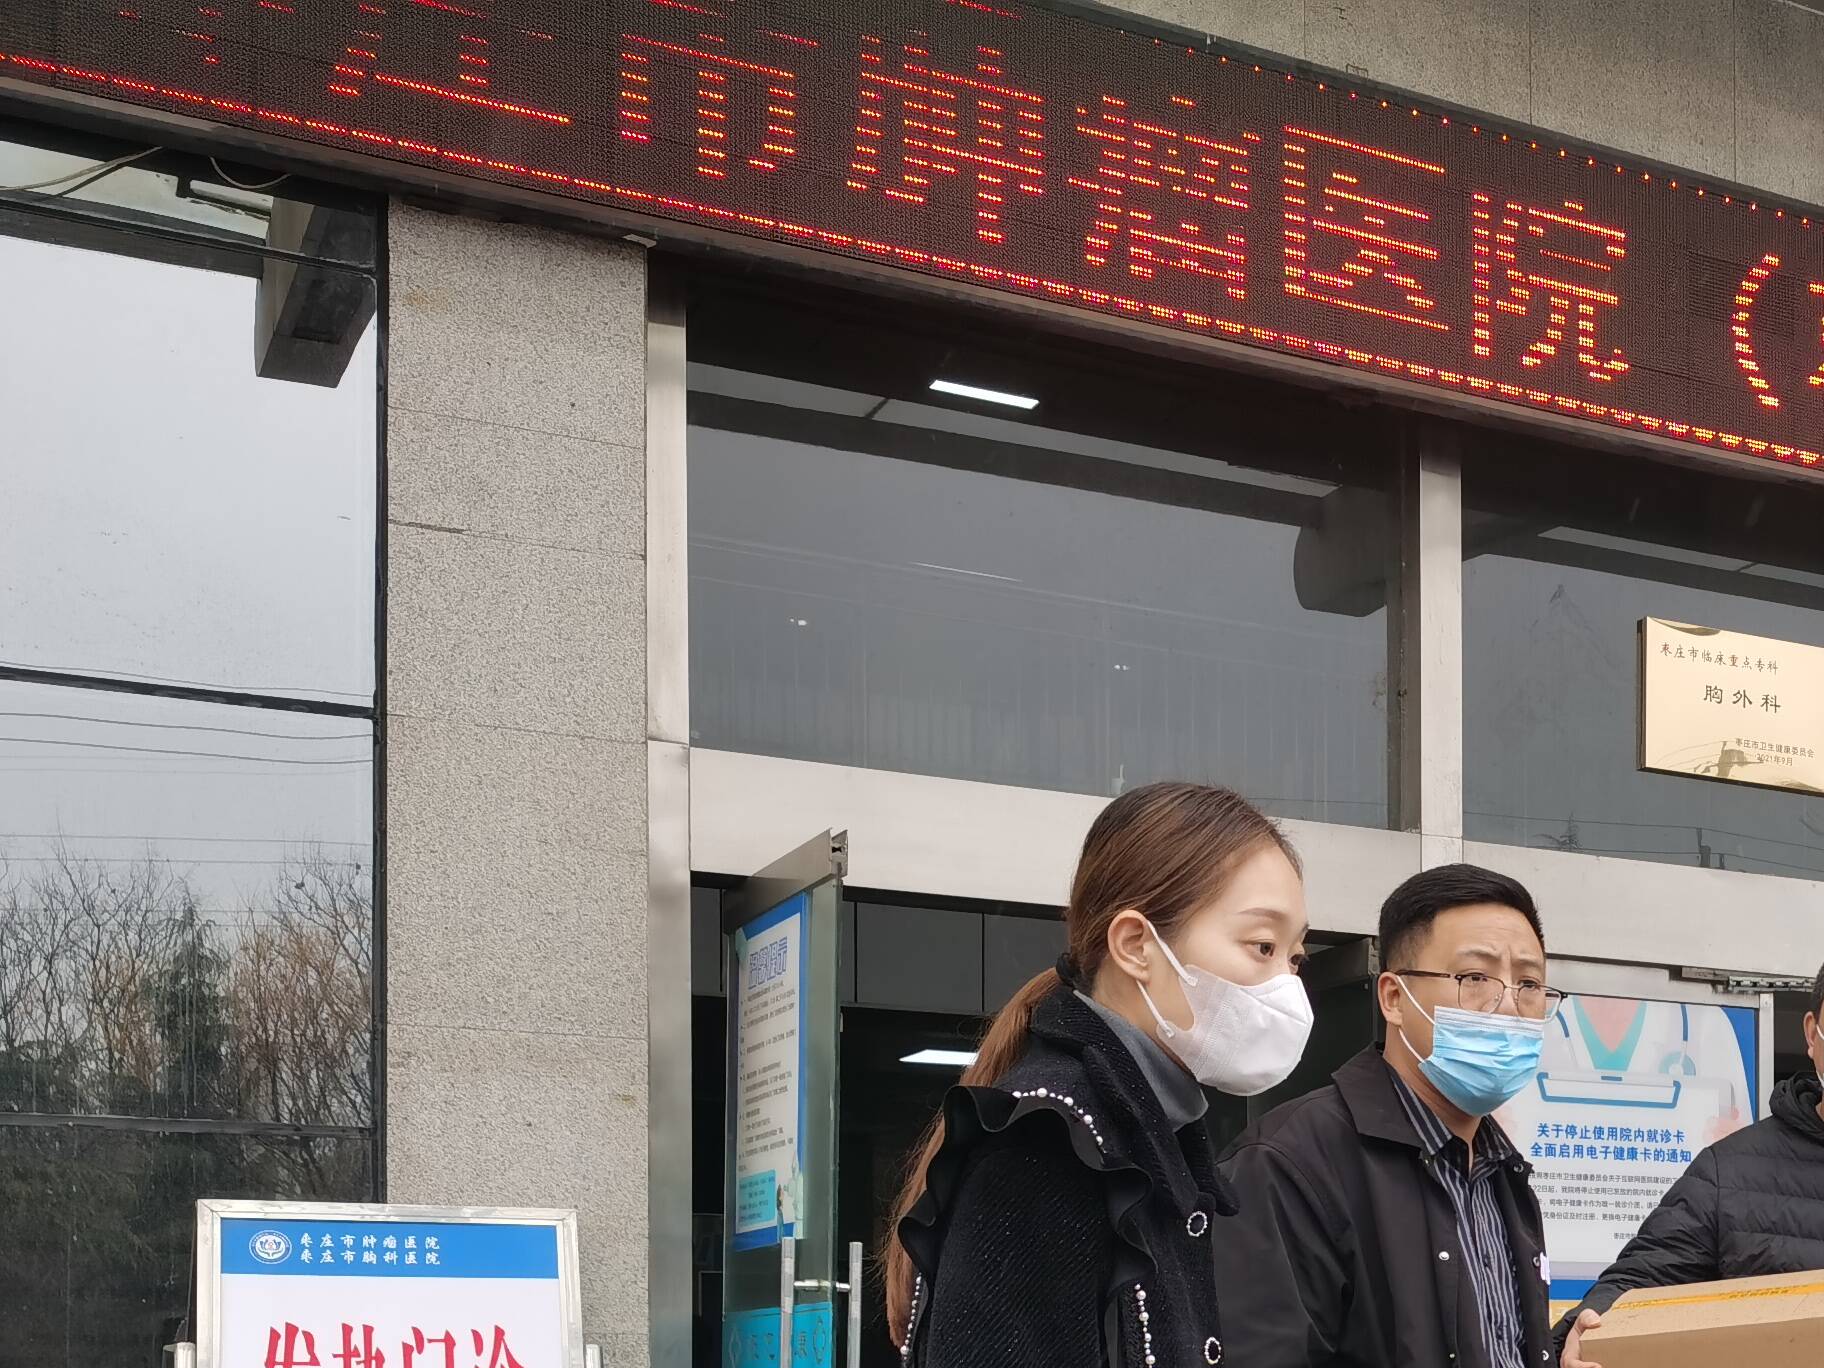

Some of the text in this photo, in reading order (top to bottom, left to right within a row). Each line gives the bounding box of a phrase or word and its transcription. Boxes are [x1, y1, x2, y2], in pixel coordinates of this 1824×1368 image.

[1659, 641, 1779, 676] 枣庄市临床重点专科
[1703, 684, 1782, 714] 胸外科
[1734, 737, 1816, 759] 枣庄市卫生健康委员会
[1536, 1122, 1686, 1145] 关于停止使用院内就诊卡
[1530, 1141, 1692, 1163] 全面启用电子健康卡的通知
[300, 1248, 441, 1265] 枣庄市胸科医院
